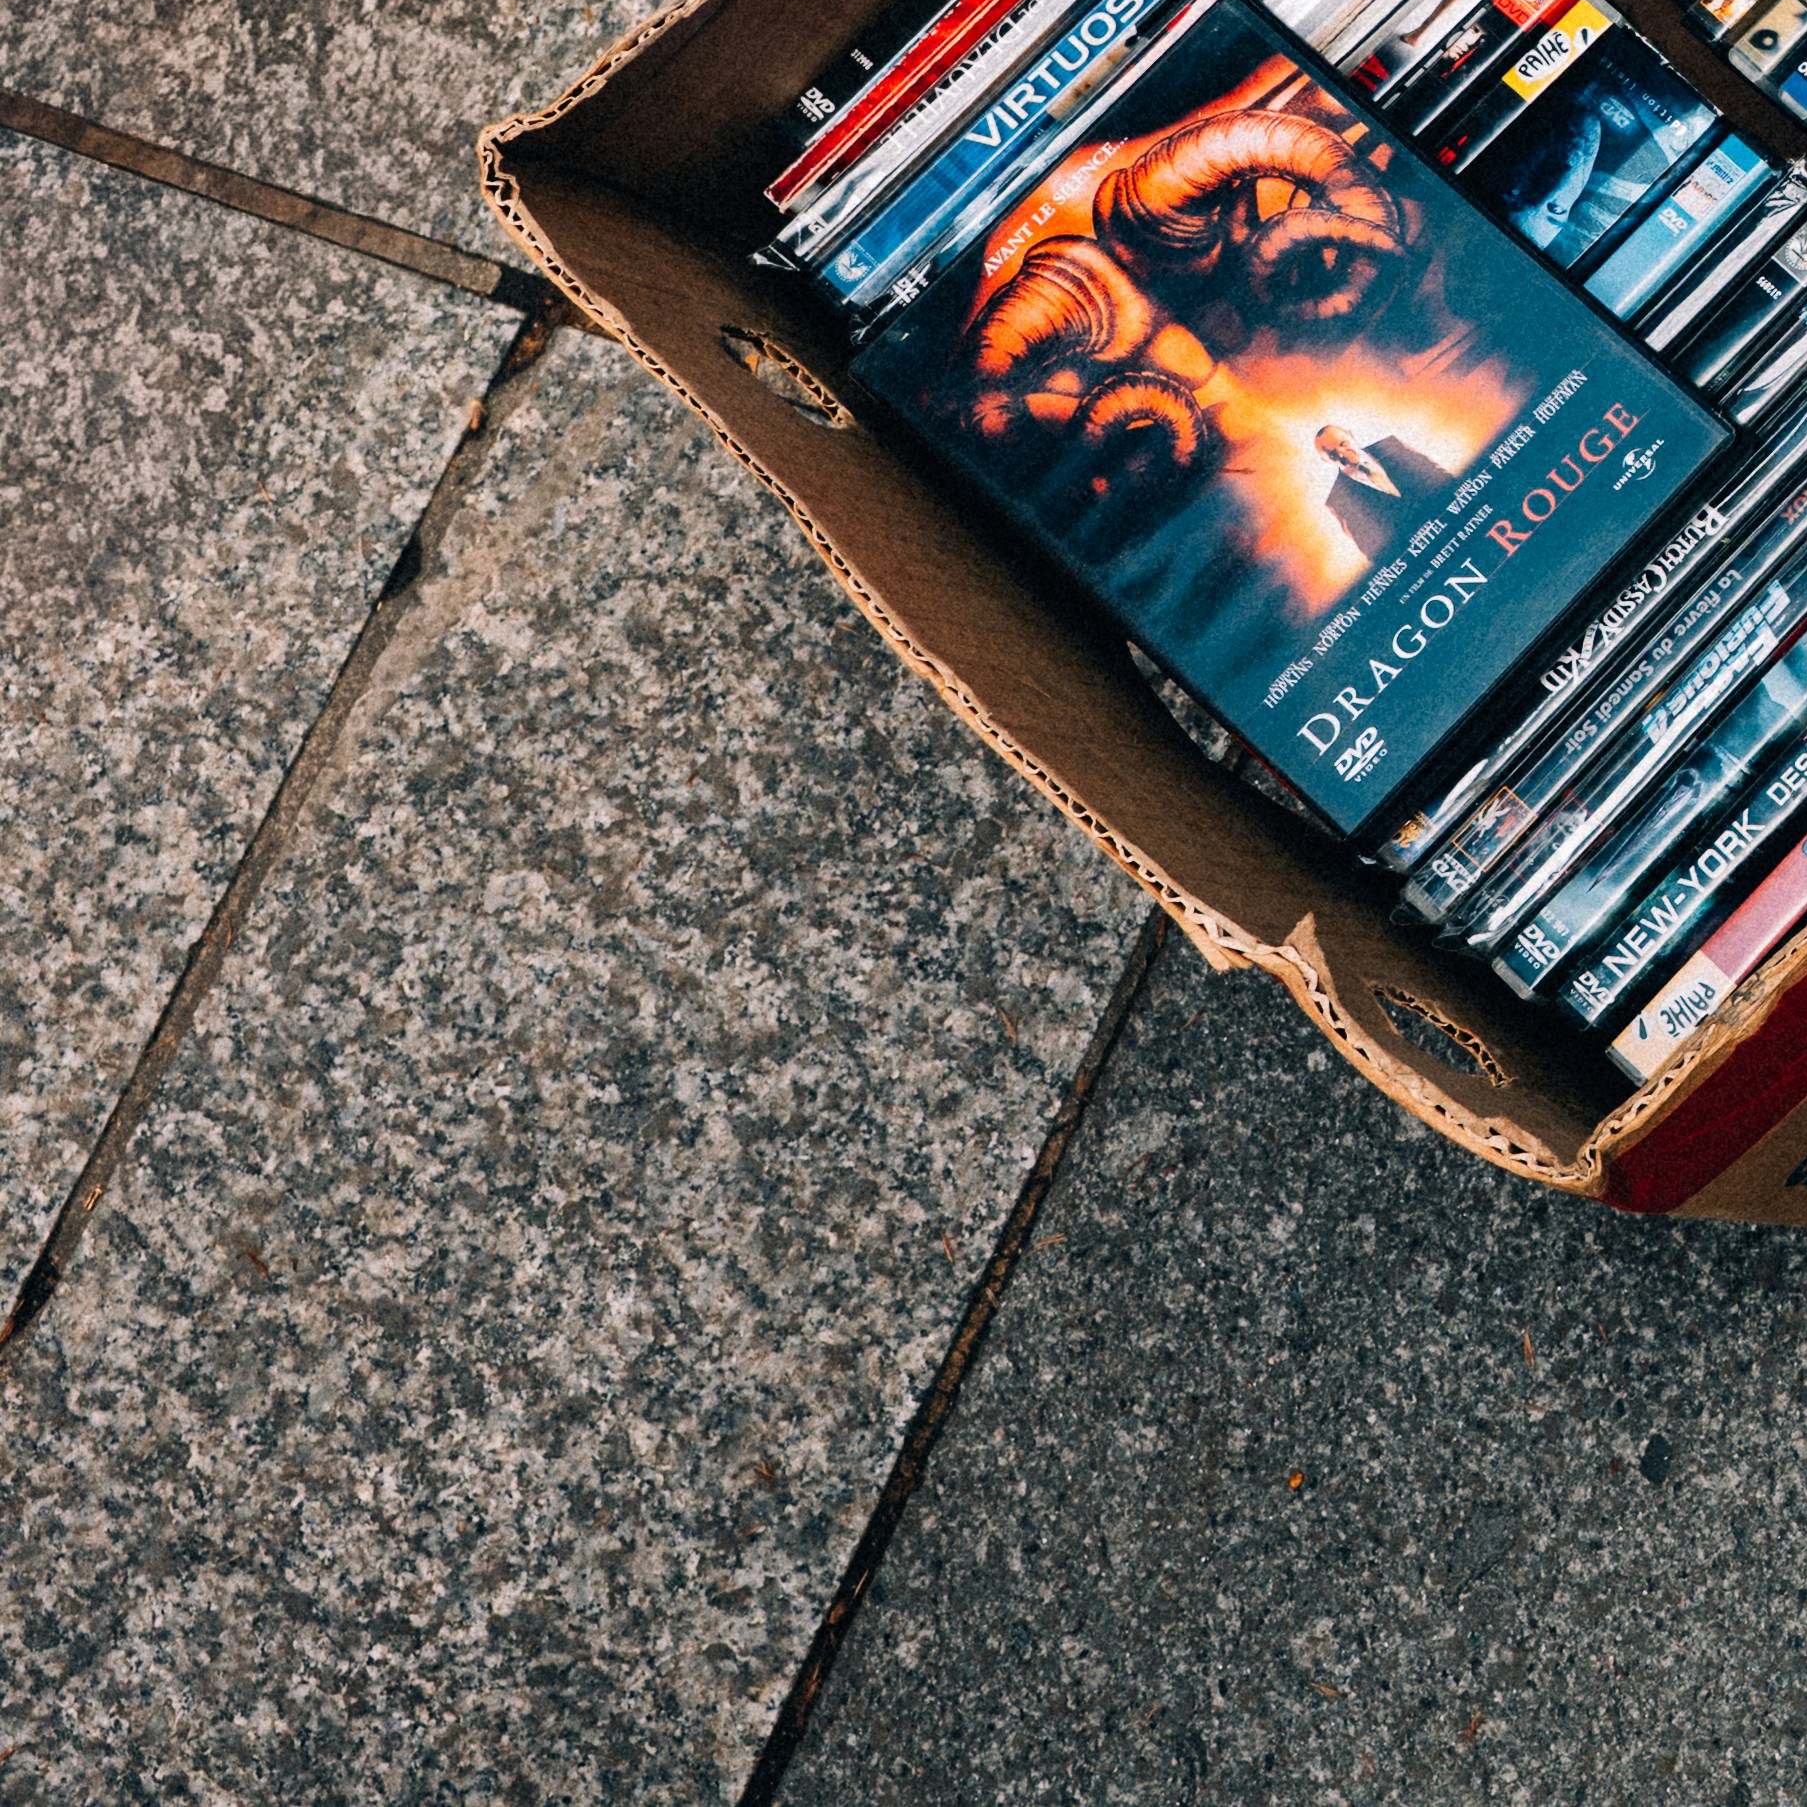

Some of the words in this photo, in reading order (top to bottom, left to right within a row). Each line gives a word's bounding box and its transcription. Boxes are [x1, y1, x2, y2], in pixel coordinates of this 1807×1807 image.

[978, 221, 1036, 277] AVANT
[1031, 201, 1056, 226] LE
[1535, 369, 1586, 424] HOFFMAN
[1491, 423, 1536, 470] PARKER
[1446, 468, 1492, 517] WATSON
[1406, 515, 1448, 558] KEITEL
[1299, 555, 1489, 758] DRAGON
[1488, 398, 1638, 558] ROUGE
[1360, 556, 1408, 606] FIENNES
[1313, 605, 1362, 656] NORTON
[1263, 655, 1314, 709] HOPKINS
[1331, 723, 1381, 776] DVD
[1354, 747, 1388, 783] VIDEO
[1604, 806, 1764, 979] NEW-YORK
